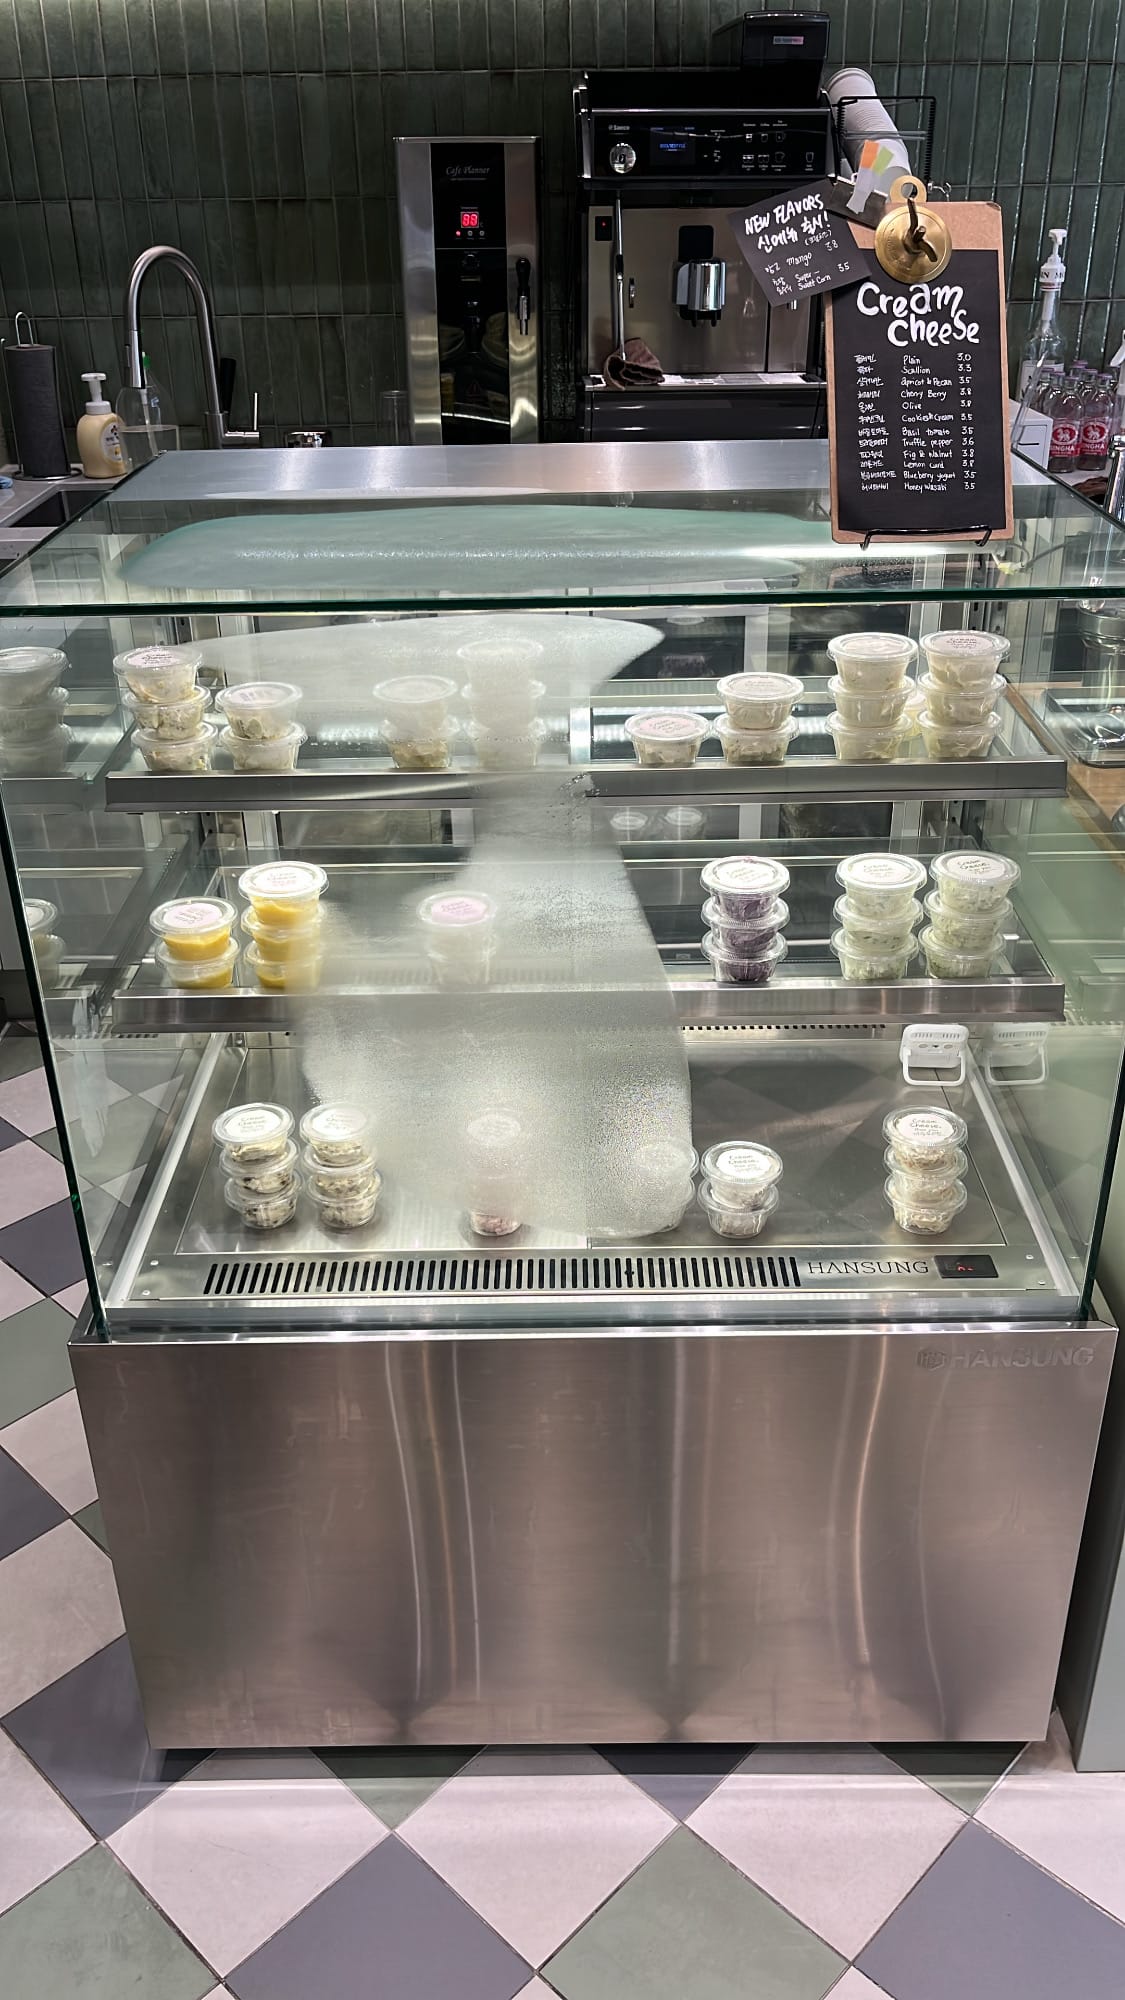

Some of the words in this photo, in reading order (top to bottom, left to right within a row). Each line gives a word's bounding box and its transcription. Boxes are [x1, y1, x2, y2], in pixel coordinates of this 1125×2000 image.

[744, 213, 771, 235] NEW
[773, 193, 824, 224] FLAVORS
[816, 274, 832, 284] Corn
[856, 281, 964, 318] Cream
[903, 354, 921, 365] Plain
[956, 352, 972, 362] 3.0
[901, 366, 931, 375] Scallion
[957, 363, 972, 372] 3.3
[932, 377, 952, 386] Pecan
[927, 389, 947, 401] Berry
[901, 401, 922, 410] Olive
[901, 426, 920, 436] Basil
[902, 438, 927, 447] Truffle
[930, 439, 954, 449] pepper
[902, 450, 917, 461] Fig
[961, 449, 975, 458] 3.8
[903, 461, 926, 469] Lemon
[903, 470, 934, 482] Blueberry
[904, 482, 924, 494] Honey
[807, 1261, 930, 1276] HANSUNG
[950, 1346, 1095, 1369] HANSUNG
